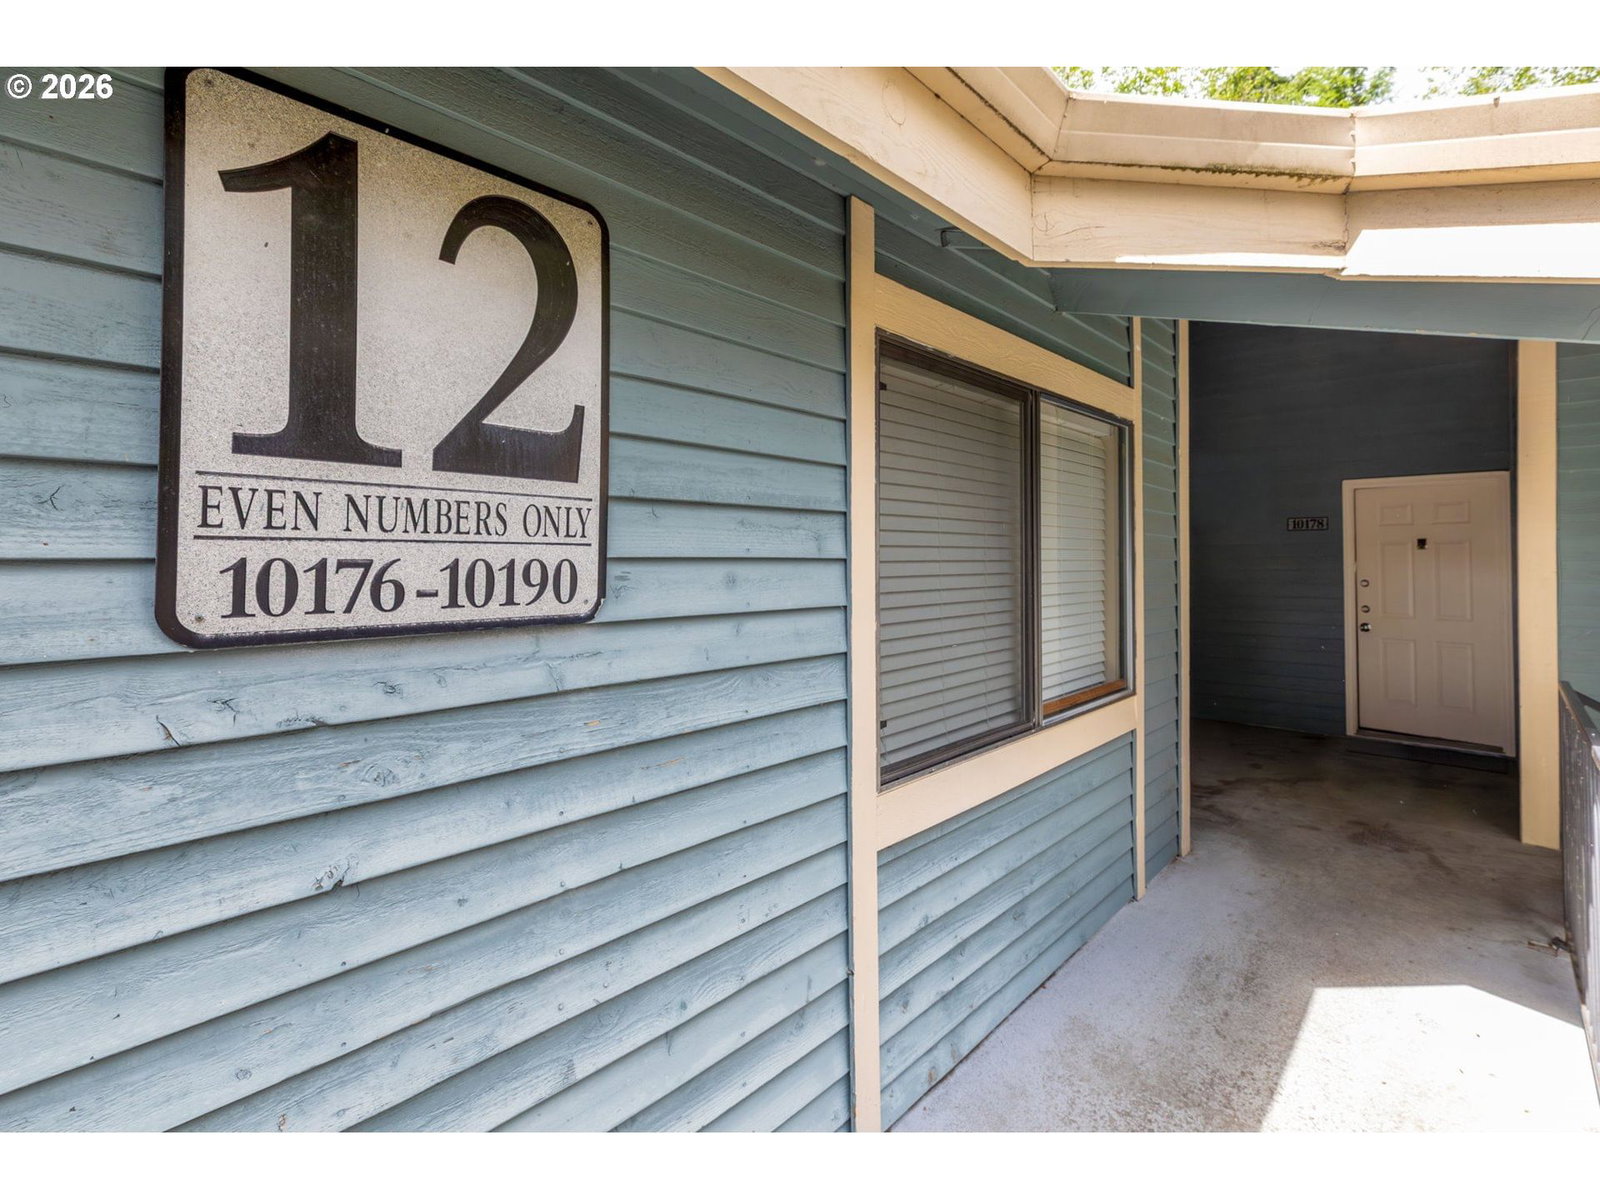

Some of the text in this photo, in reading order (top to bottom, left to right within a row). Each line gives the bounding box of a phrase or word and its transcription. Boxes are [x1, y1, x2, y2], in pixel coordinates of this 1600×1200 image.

[218, 131, 585, 483] 12
[197, 485, 592, 539] EVEN NUMBERS ONLY
[1292, 519, 1325, 529] 10178
